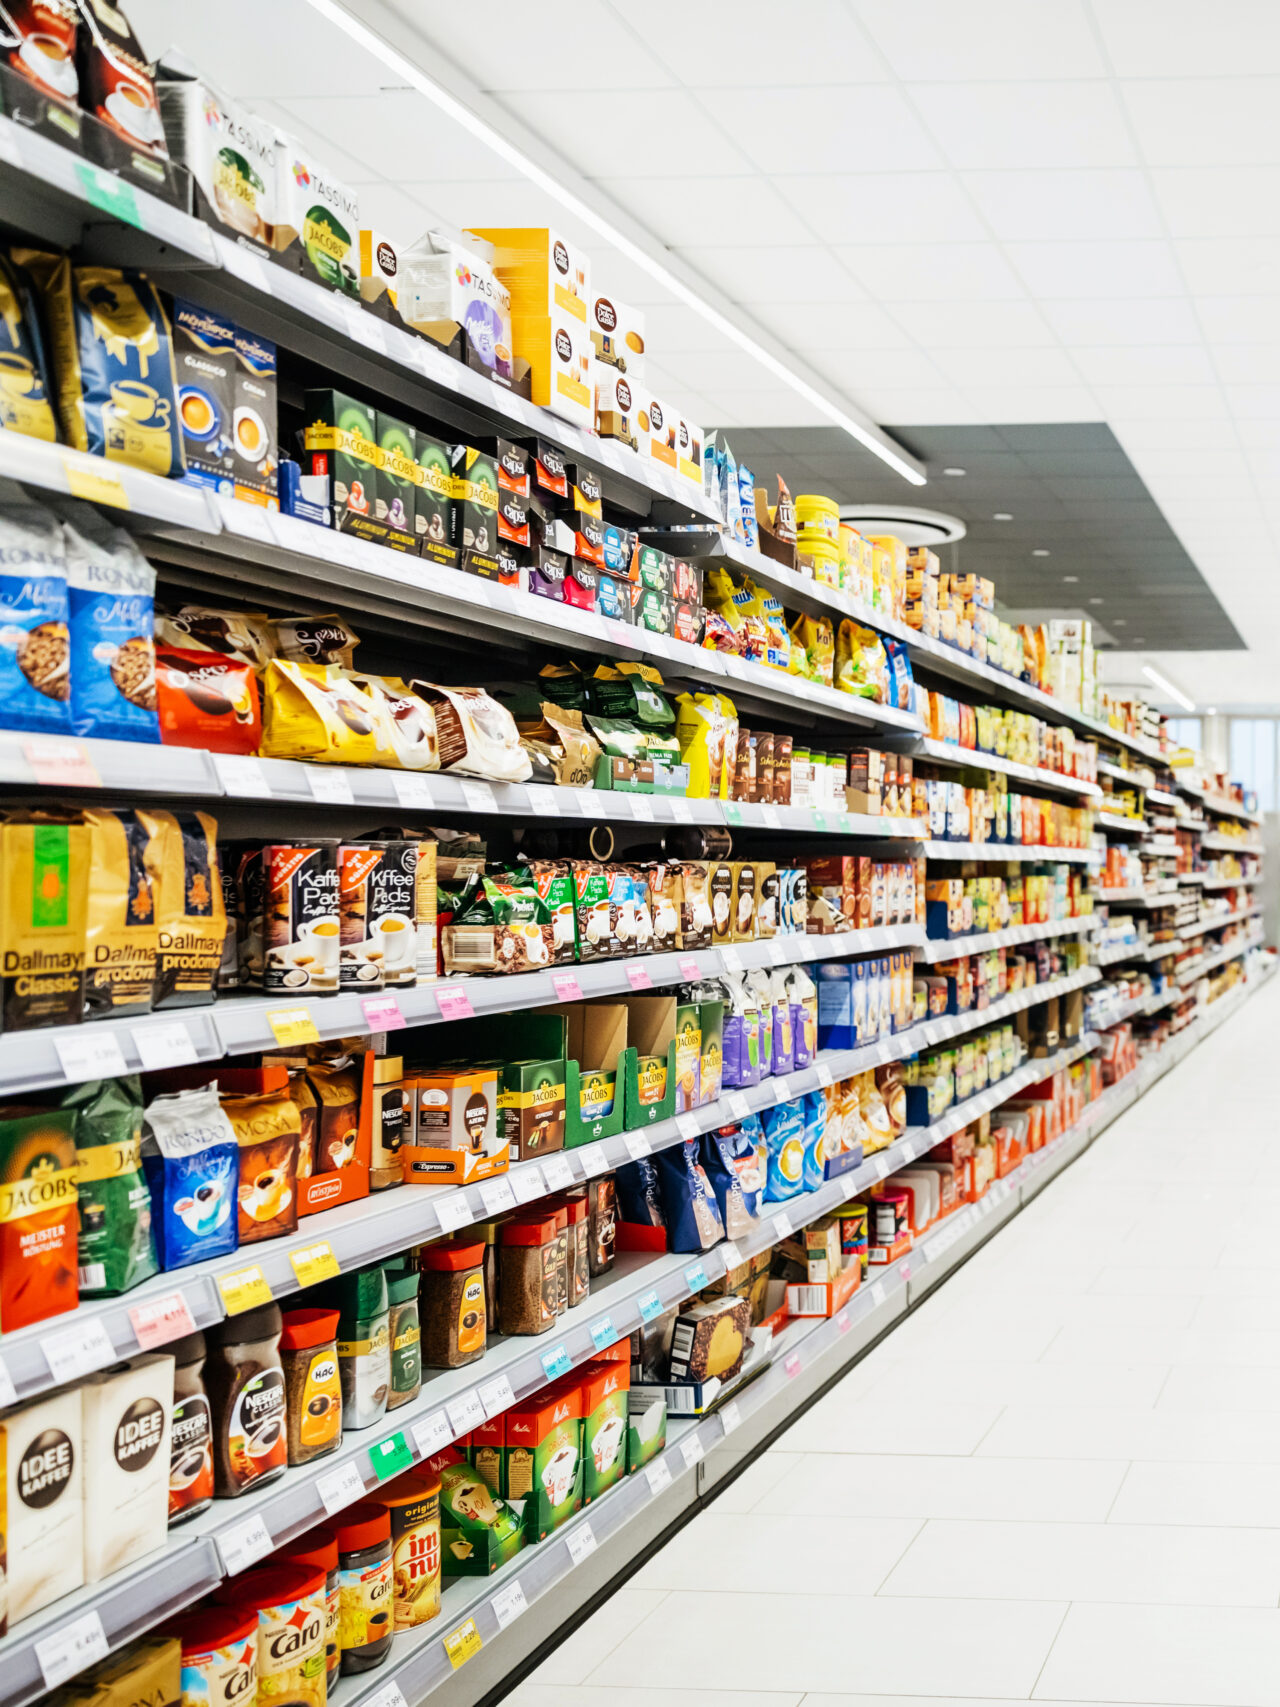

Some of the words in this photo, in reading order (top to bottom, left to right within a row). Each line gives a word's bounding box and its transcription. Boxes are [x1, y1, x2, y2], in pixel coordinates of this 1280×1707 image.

[312, 175, 360, 221] TASSIMO
[308, 224, 345, 257] JACOBS
[338, 431, 376, 460] JACOBS
[380, 455, 415, 478] JACOBS
[419, 469, 452, 493] JACOBS
[469, 484, 499, 507] JACOBS
[346, 852, 362, 868] GUT
[375, 887, 411, 904] Pads
[95, 945, 157, 964] Dallma
[15, 976, 79, 997] Classic
[677, 1035, 699, 1049] JACOBS
[703, 1055, 722, 1069] JACOBS
[642, 1072, 664, 1087] JACOBS
[533, 1089, 558, 1104] JACOBS
[583, 1087, 608, 1103] JACOBS
[237, 1117, 292, 1141] MONA
[420, 1163, 447, 1172] Espresso
[5, 1174, 79, 1211] JACOBS
[467, 1287, 481, 1298] HAG
[396, 1328, 421, 1348] JACOBS
[314, 1366, 334, 1379] HAG
[119, 1411, 163, 1443] IDEE
[118, 1432, 161, 1462] KAFFEE
[22, 1444, 70, 1476] IDEE
[23, 1464, 70, 1496] KAFFEE
[409, 1531, 437, 1557] im
[408, 1555, 437, 1579] nu
[271, 1619, 320, 1659] Caro
[224, 1664, 257, 1700] Car
